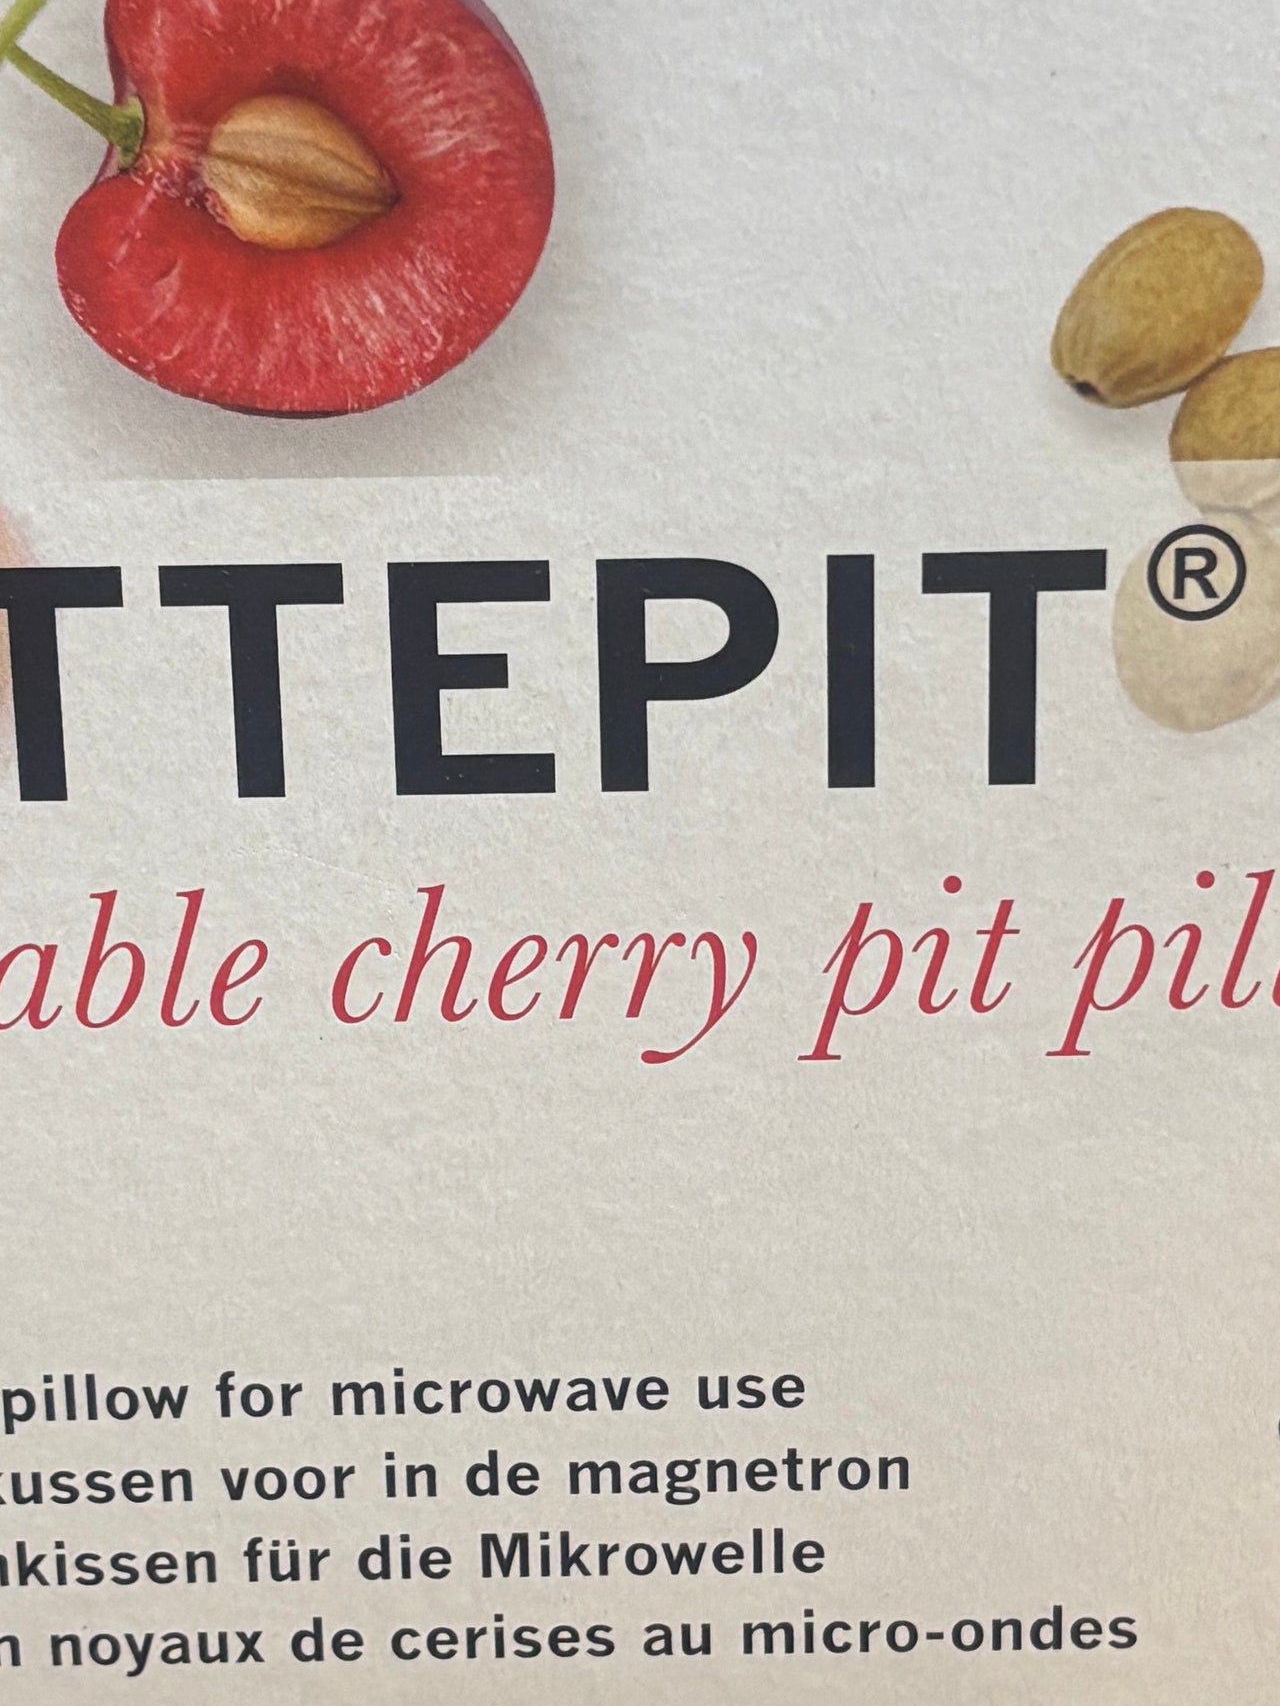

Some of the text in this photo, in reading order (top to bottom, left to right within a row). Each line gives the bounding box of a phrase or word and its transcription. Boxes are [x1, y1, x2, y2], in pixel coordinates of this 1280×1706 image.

[330, 885, 757, 1064] cherry
[800, 876, 1020, 1061] pit
[1, 1373, 189, 1435] pillow
[214, 1370, 304, 1418] for
[331, 1366, 670, 1417] microwave
[697, 1374, 806, 1410] use
[219, 1465, 356, 1501] voor
[384, 1450, 438, 1499] in
[465, 1448, 541, 1497] de
[568, 1448, 910, 1506] magnetron
[242, 1536, 331, 1583] für
[357, 1533, 453, 1581] die
[480, 1528, 826, 1579] Mikrowelle
[49, 1631, 266, 1678] noyaux
[290, 1617, 365, 1663] de
[390, 1614, 616, 1662] cerises
[642, 1622, 712, 1656] au
[742, 1605, 1139, 1655] micro-ondes
